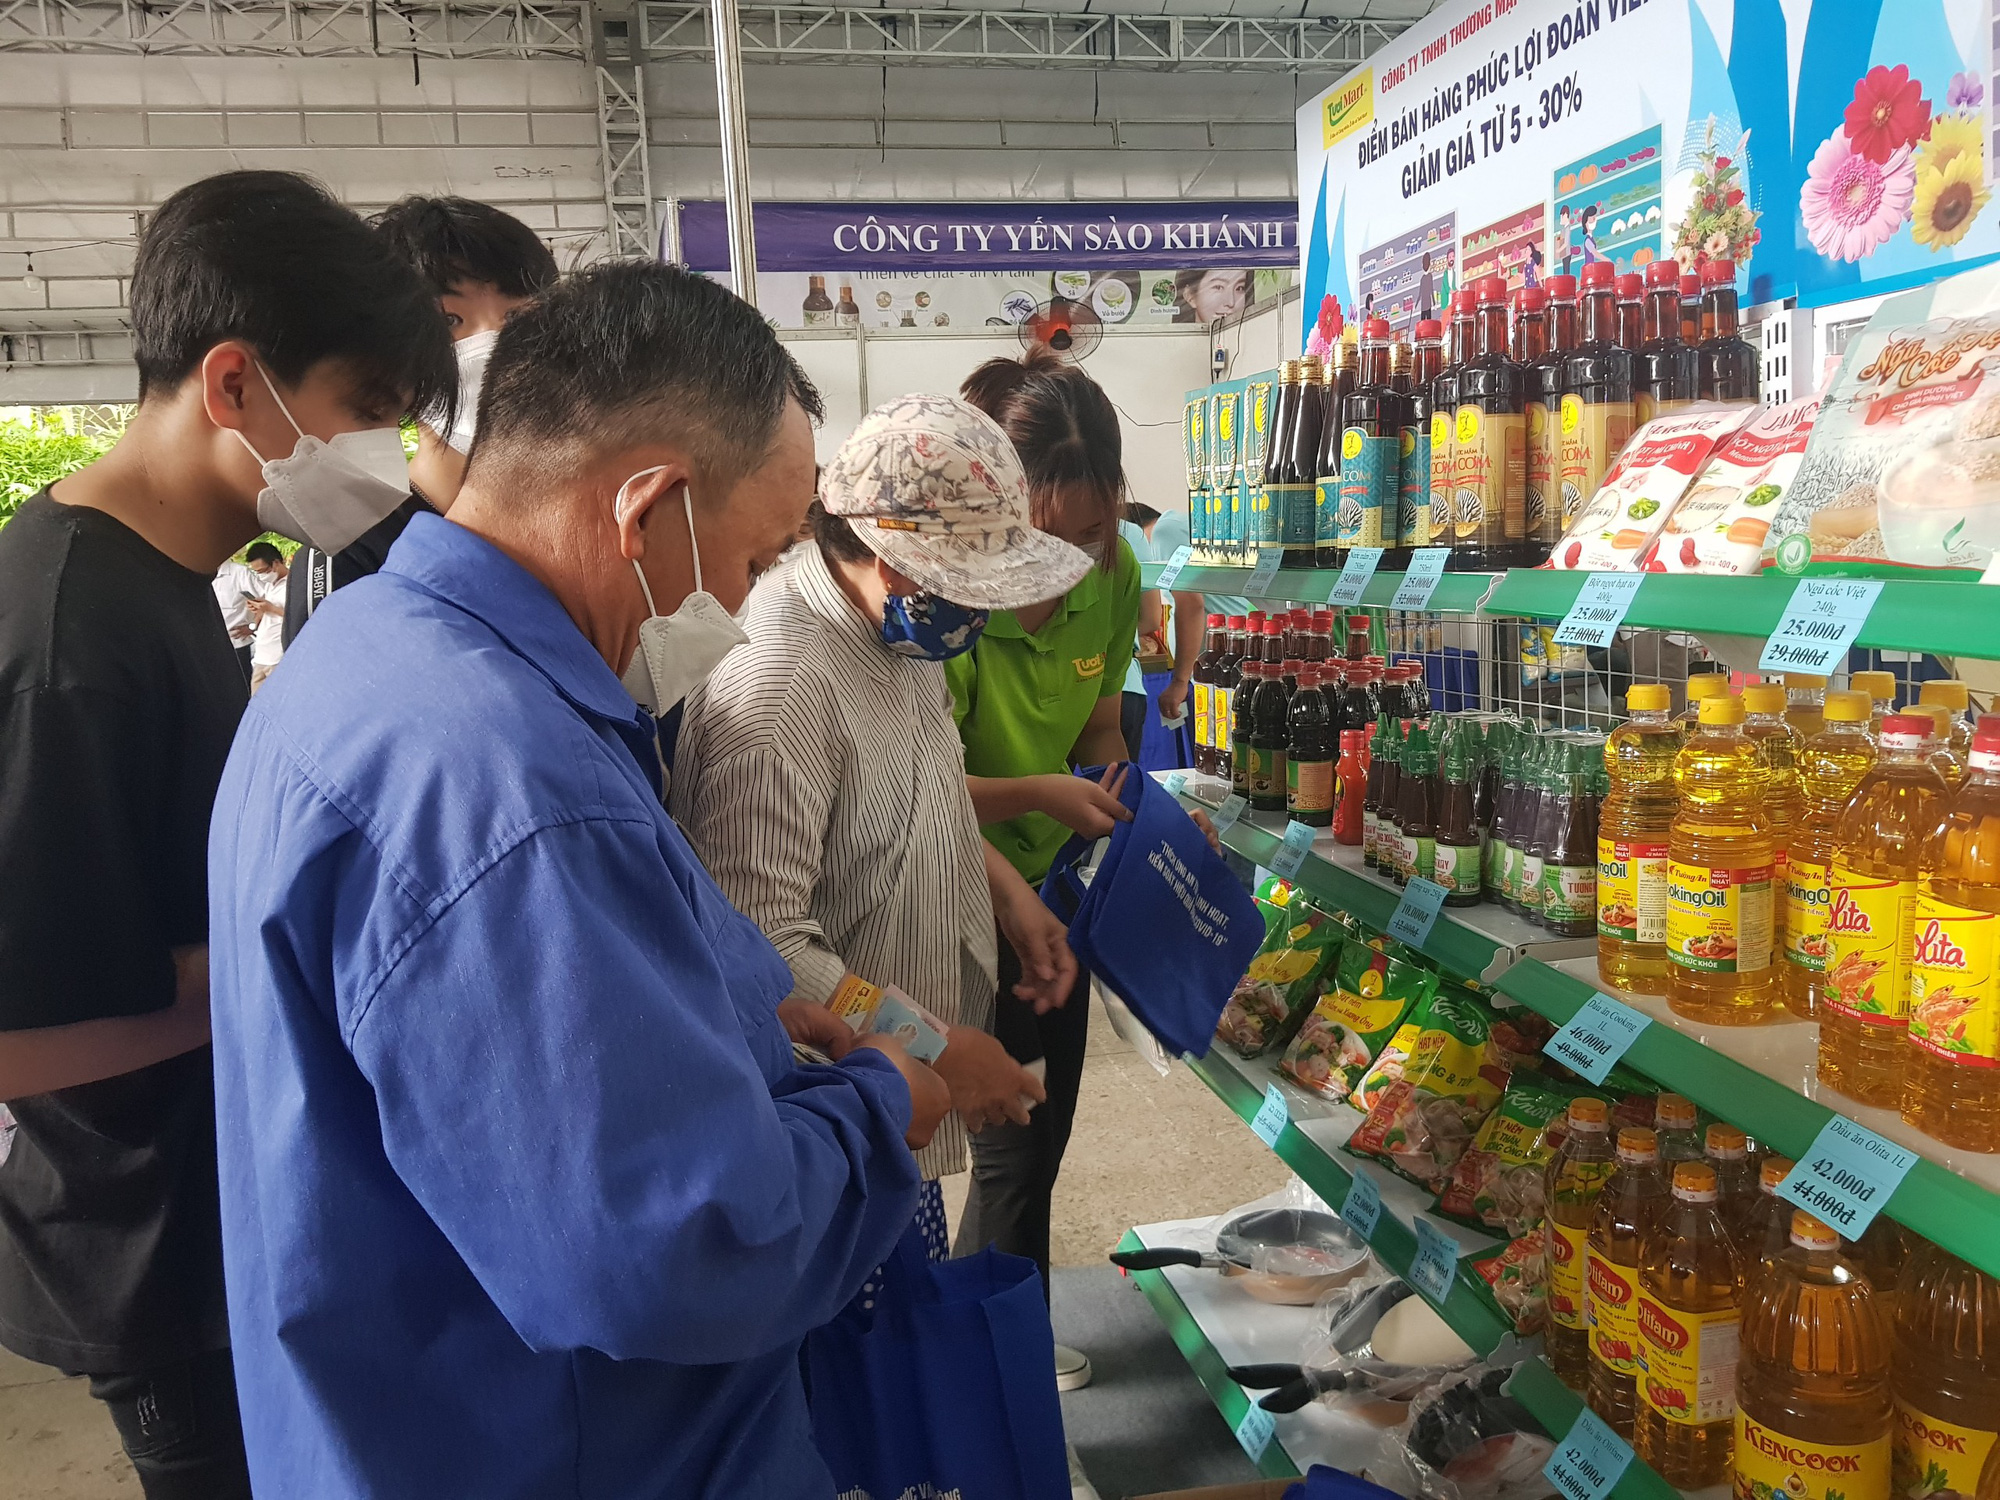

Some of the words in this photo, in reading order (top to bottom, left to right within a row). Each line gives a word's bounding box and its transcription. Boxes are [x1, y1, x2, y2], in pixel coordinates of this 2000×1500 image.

[1408, 53, 1418, 75] TY
[1421, 34, 1447, 67] TNHH
[1450, 4, 1492, 48] THƯƠNG
[1343, 82, 1364, 108] Mart
[1358, 118, 1388, 169] ĐIỂM
[1391, 106, 1418, 150] BÁN
[1422, 87, 1462, 133] HÀNG
[1466, 50, 1509, 106] PHÚC
[1514, 28, 1541, 82] LỢI
[1401, 143, 1441, 199] GIẢM
[1446, 119, 1476, 177] GIÁ
[1480, 103, 1506, 158] TỪ
[1510, 104, 1521, 144] 5
[1539, 70, 1582, 129] 30%
[833, 215, 940, 252] CÔNG
[948, 224, 994, 252] TY
[1002, 216, 1074, 252] YẾN
[1084, 215, 1152, 251] SÀO
[1160, 214, 1285, 250] KHÁNH
[1803, 582, 1826, 597] Ngũ
[1824, 581, 1844, 597] cốc
[1846, 585, 1867, 601] Việt
[1812, 600, 1838, 617] 240g
[1572, 606, 1618, 622] 25.000đ
[1782, 618, 1847, 641] 25.000đ
[1559, 626, 1606, 644] 27.000đ
[1767, 643, 1830, 667] 29.000đ
[1401, 903, 1429, 924] 10.000đ
[1685, 956, 1698, 967] SỨC
[1698, 958, 1719, 969] KHỎE
[1587, 999, 1602, 1014] Dầu
[1600, 1007, 1610, 1018] ăn
[1609, 1009, 1638, 1034] Cooking
[1569, 1025, 1612, 1056] 46.000đ
[1830, 1120, 1851, 1139] Dầu
[1850, 1132, 1864, 1146] ăn
[1864, 1137, 1891, 1161] Olita
[1811, 1157, 1877, 1203] 42.000đ
[1792, 1179, 1857, 1227] 44.000đ
[1744, 1417, 1861, 1474] KENCOOK
[1902, 1411, 1967, 1455] COOK
[1565, 1447, 1606, 1489] 42.000đ
[1602, 1438, 1624, 1464] Olifam
[1552, 1463, 1592, 1500] 44.000đ
